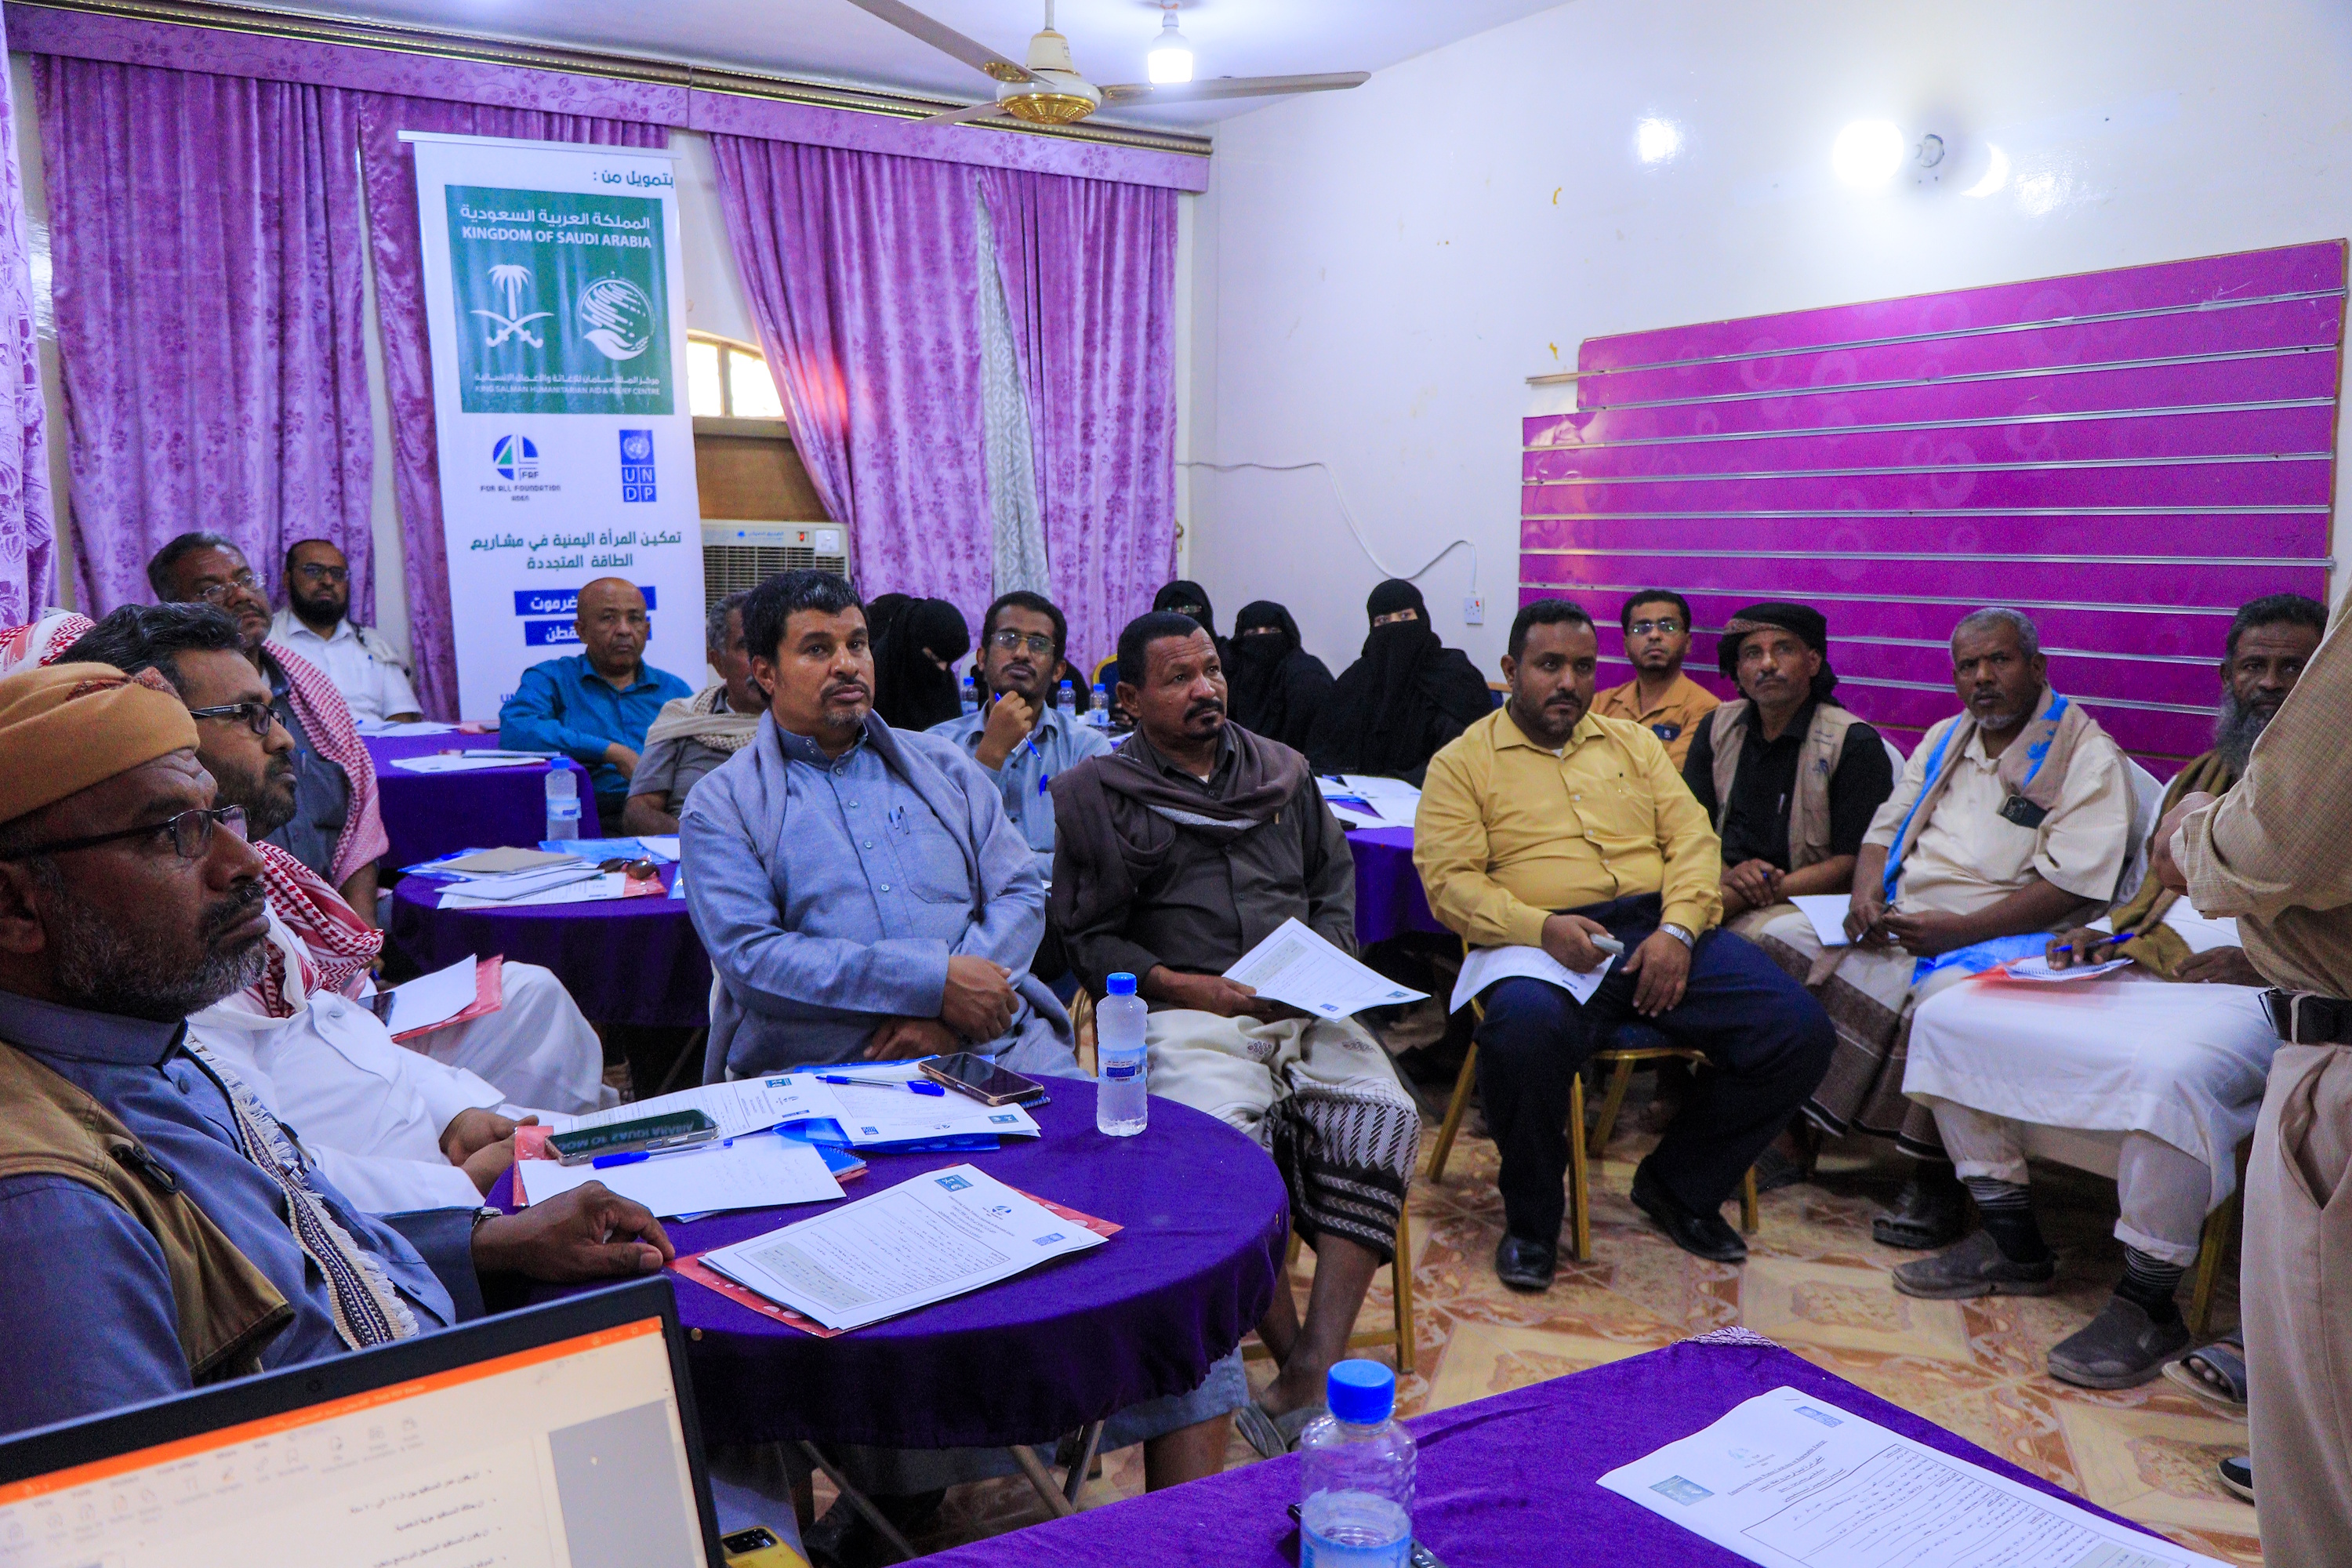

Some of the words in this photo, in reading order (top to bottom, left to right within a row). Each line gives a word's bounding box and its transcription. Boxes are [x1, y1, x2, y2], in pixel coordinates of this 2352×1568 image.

[602, 170, 622, 184] من
[627, 170, 674, 189] بتمويل
[459, 204, 535, 223] السعودية
[539, 209, 590, 228] العربية
[593, 212, 651, 230] المملكة
[462, 227, 533, 242] KINGDOM
[535, 230, 554, 243] OF
[557, 232, 600, 246] SAUDI
[602, 235, 652, 249] ARABIA
[529, 535, 548, 551] في
[553, 532, 595, 549] اليمنية
[600, 528, 637, 546] المرأة
[641, 531, 681, 546] تمكين
[527, 555, 583, 572] المتجددة
[591, 554, 633, 568] الطاقة
[531, 596, 578, 612] ضرموت
